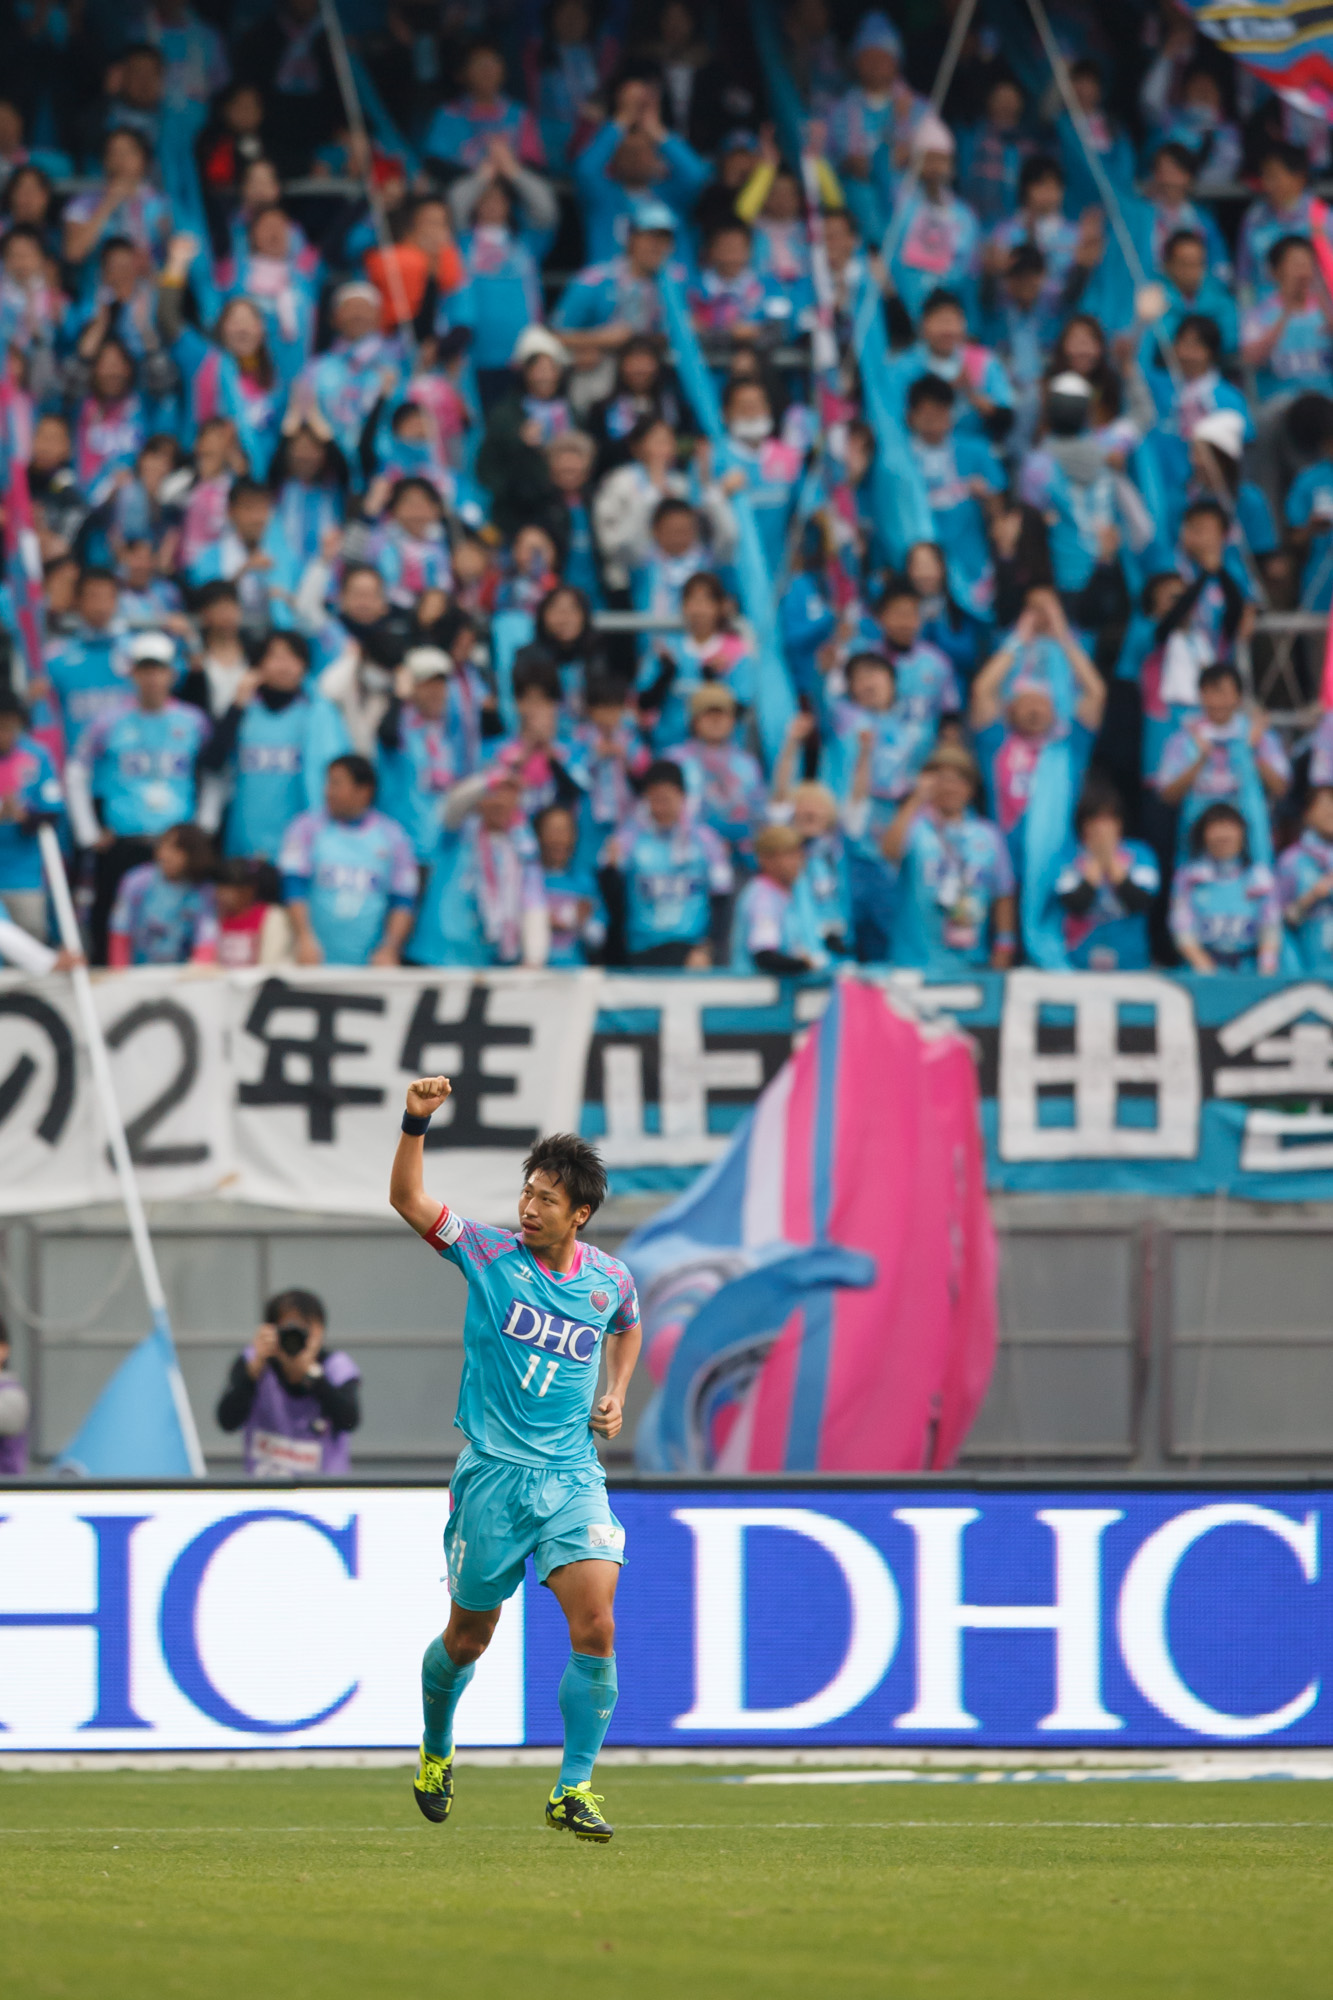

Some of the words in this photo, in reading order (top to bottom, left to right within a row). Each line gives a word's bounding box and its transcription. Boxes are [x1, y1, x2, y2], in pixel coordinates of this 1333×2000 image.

[586, 972, 1333, 1171] 正田舎
[503, 1299, 600, 1363] DHC
[520, 1353, 559, 1398] 11
[672, 1503, 1320, 1735] DHC
